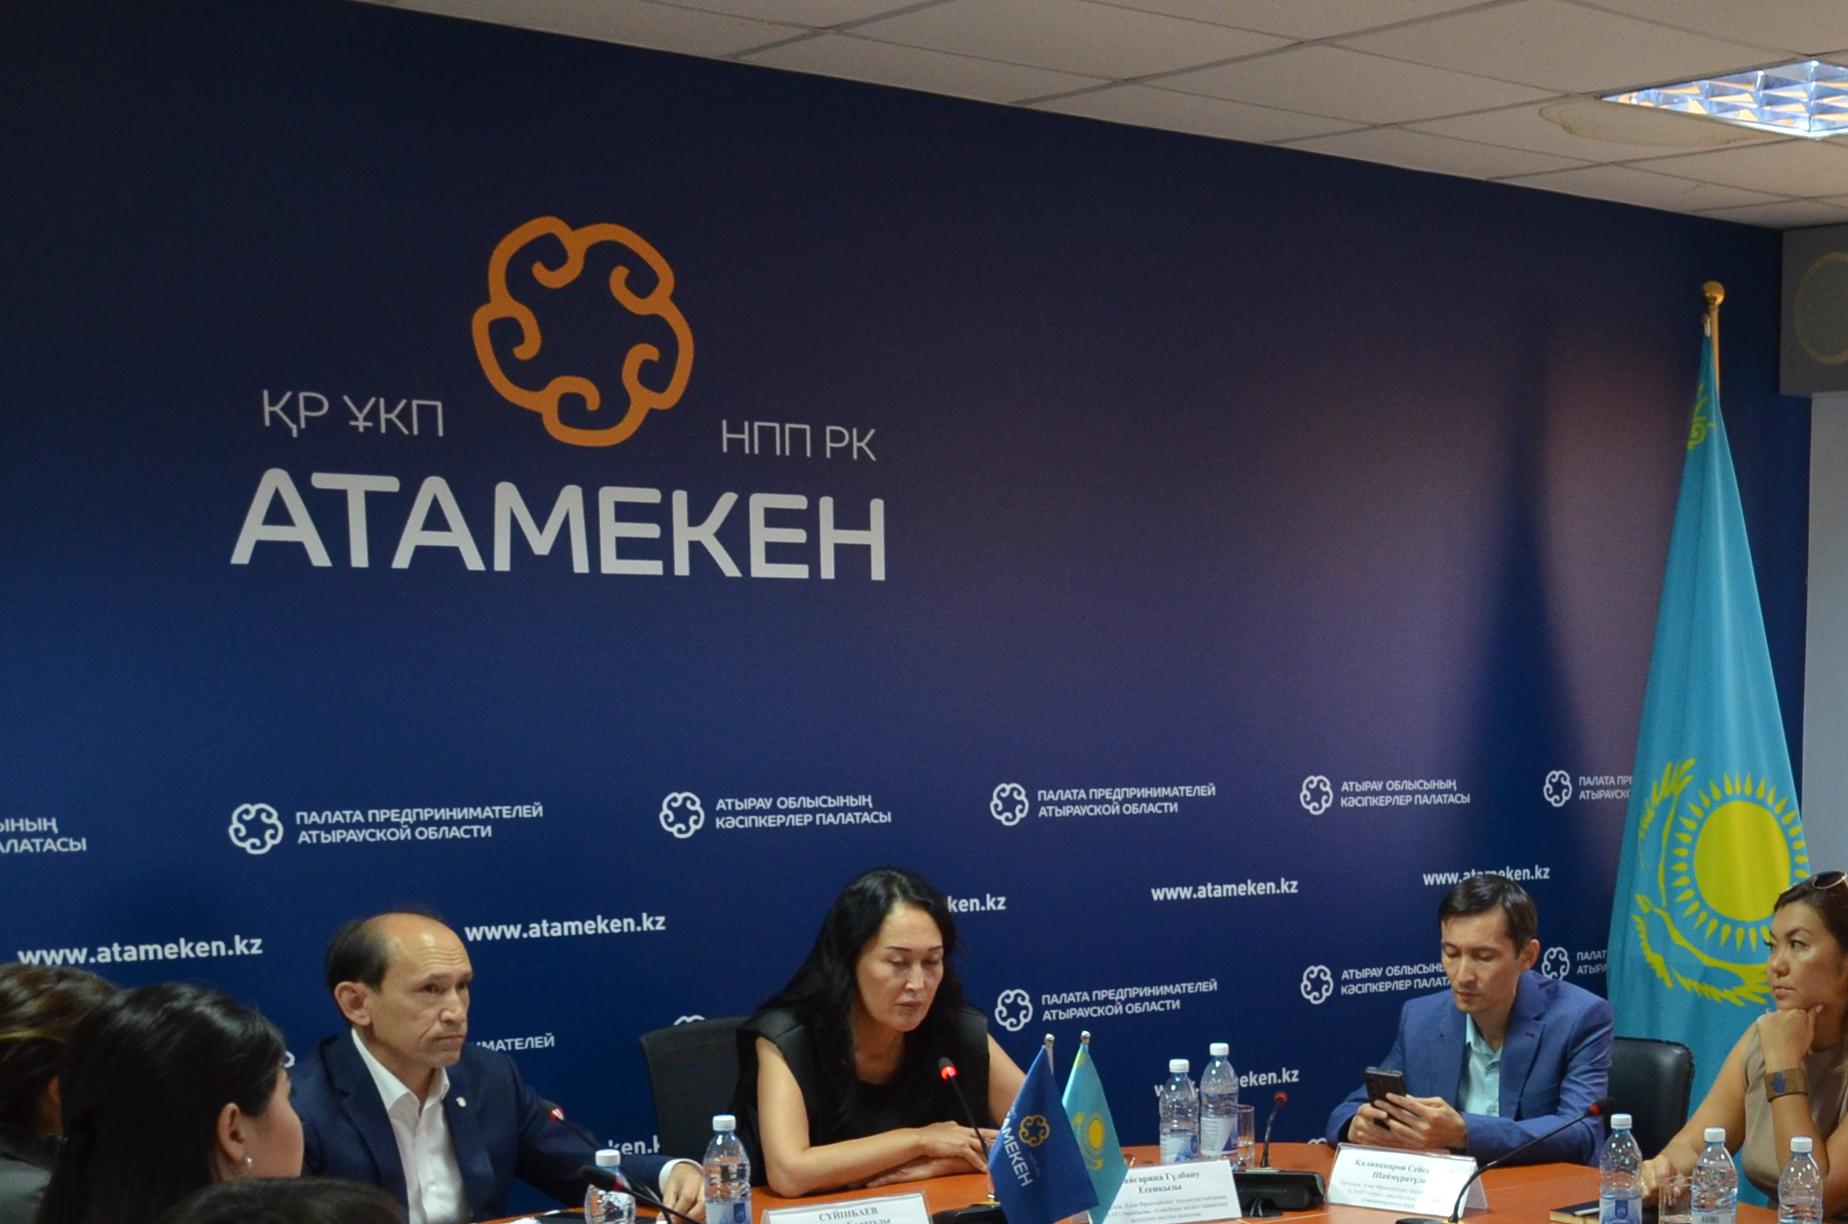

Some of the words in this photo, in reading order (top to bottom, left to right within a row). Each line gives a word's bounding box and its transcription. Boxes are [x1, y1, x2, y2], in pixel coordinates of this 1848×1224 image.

[263, 389, 329, 438] ҚР
[342, 394, 445, 437] ҰКП
[722, 419, 811, 458] НПП
[826, 425, 877, 461] РК
[229, 467, 886, 581] АТАМЕКЕН
[1341, 780, 1384, 792] АТЫРАУ
[1579, 776, 1615, 786] ПАЛАТА
[1037, 789, 1087, 802] ПАЛАТА
[1089, 782, 1216, 802] ПРЕДПРИНИМАТЕЛЕЙ
[1414, 793, 1471, 805] ПАЛАТАСЫ
[296, 810, 365, 825] ПАЛАТА
[367, 801, 544, 824] ПРЕДПРИНИМАТЕЛЕЙ
[715, 797, 774, 812] АТЫРАУ
[1038, 801, 1120, 818] АТЫРАУСКОЙ
[1122, 802, 1178, 815] ОБЛАСТИ
[0, 817, 58, 834] ЫНЫҢ
[816, 811, 892, 825] ПАЛАТАСЫ
[297, 824, 412, 844] АТЫРАУСКОЙ
[414, 825, 493, 839] ОБЛАСТИ
[1150, 877, 1298, 901] www.atameken.kz
[947, 893, 1006, 913] ken.kz
[464, 912, 666, 942] www.atameken.kz
[17, 935, 263, 966] www.atameken.kz
[1576, 950, 1607, 961] ПАЛАТ
[1341, 967, 1384, 980] АТЫРАУ
[1042, 991, 1090, 1005] ПАЛАТА
[1092, 978, 1218, 1001] ПРЕДПРИНИМАТЕЛЕЙ
[1042, 1002, 1123, 1021] АТЫРАУСКОЙ
[1125, 1000, 1181, 1014] ОБЛАСТИ
[476, 1032, 555, 1052] МАТЕЛЕЙ
